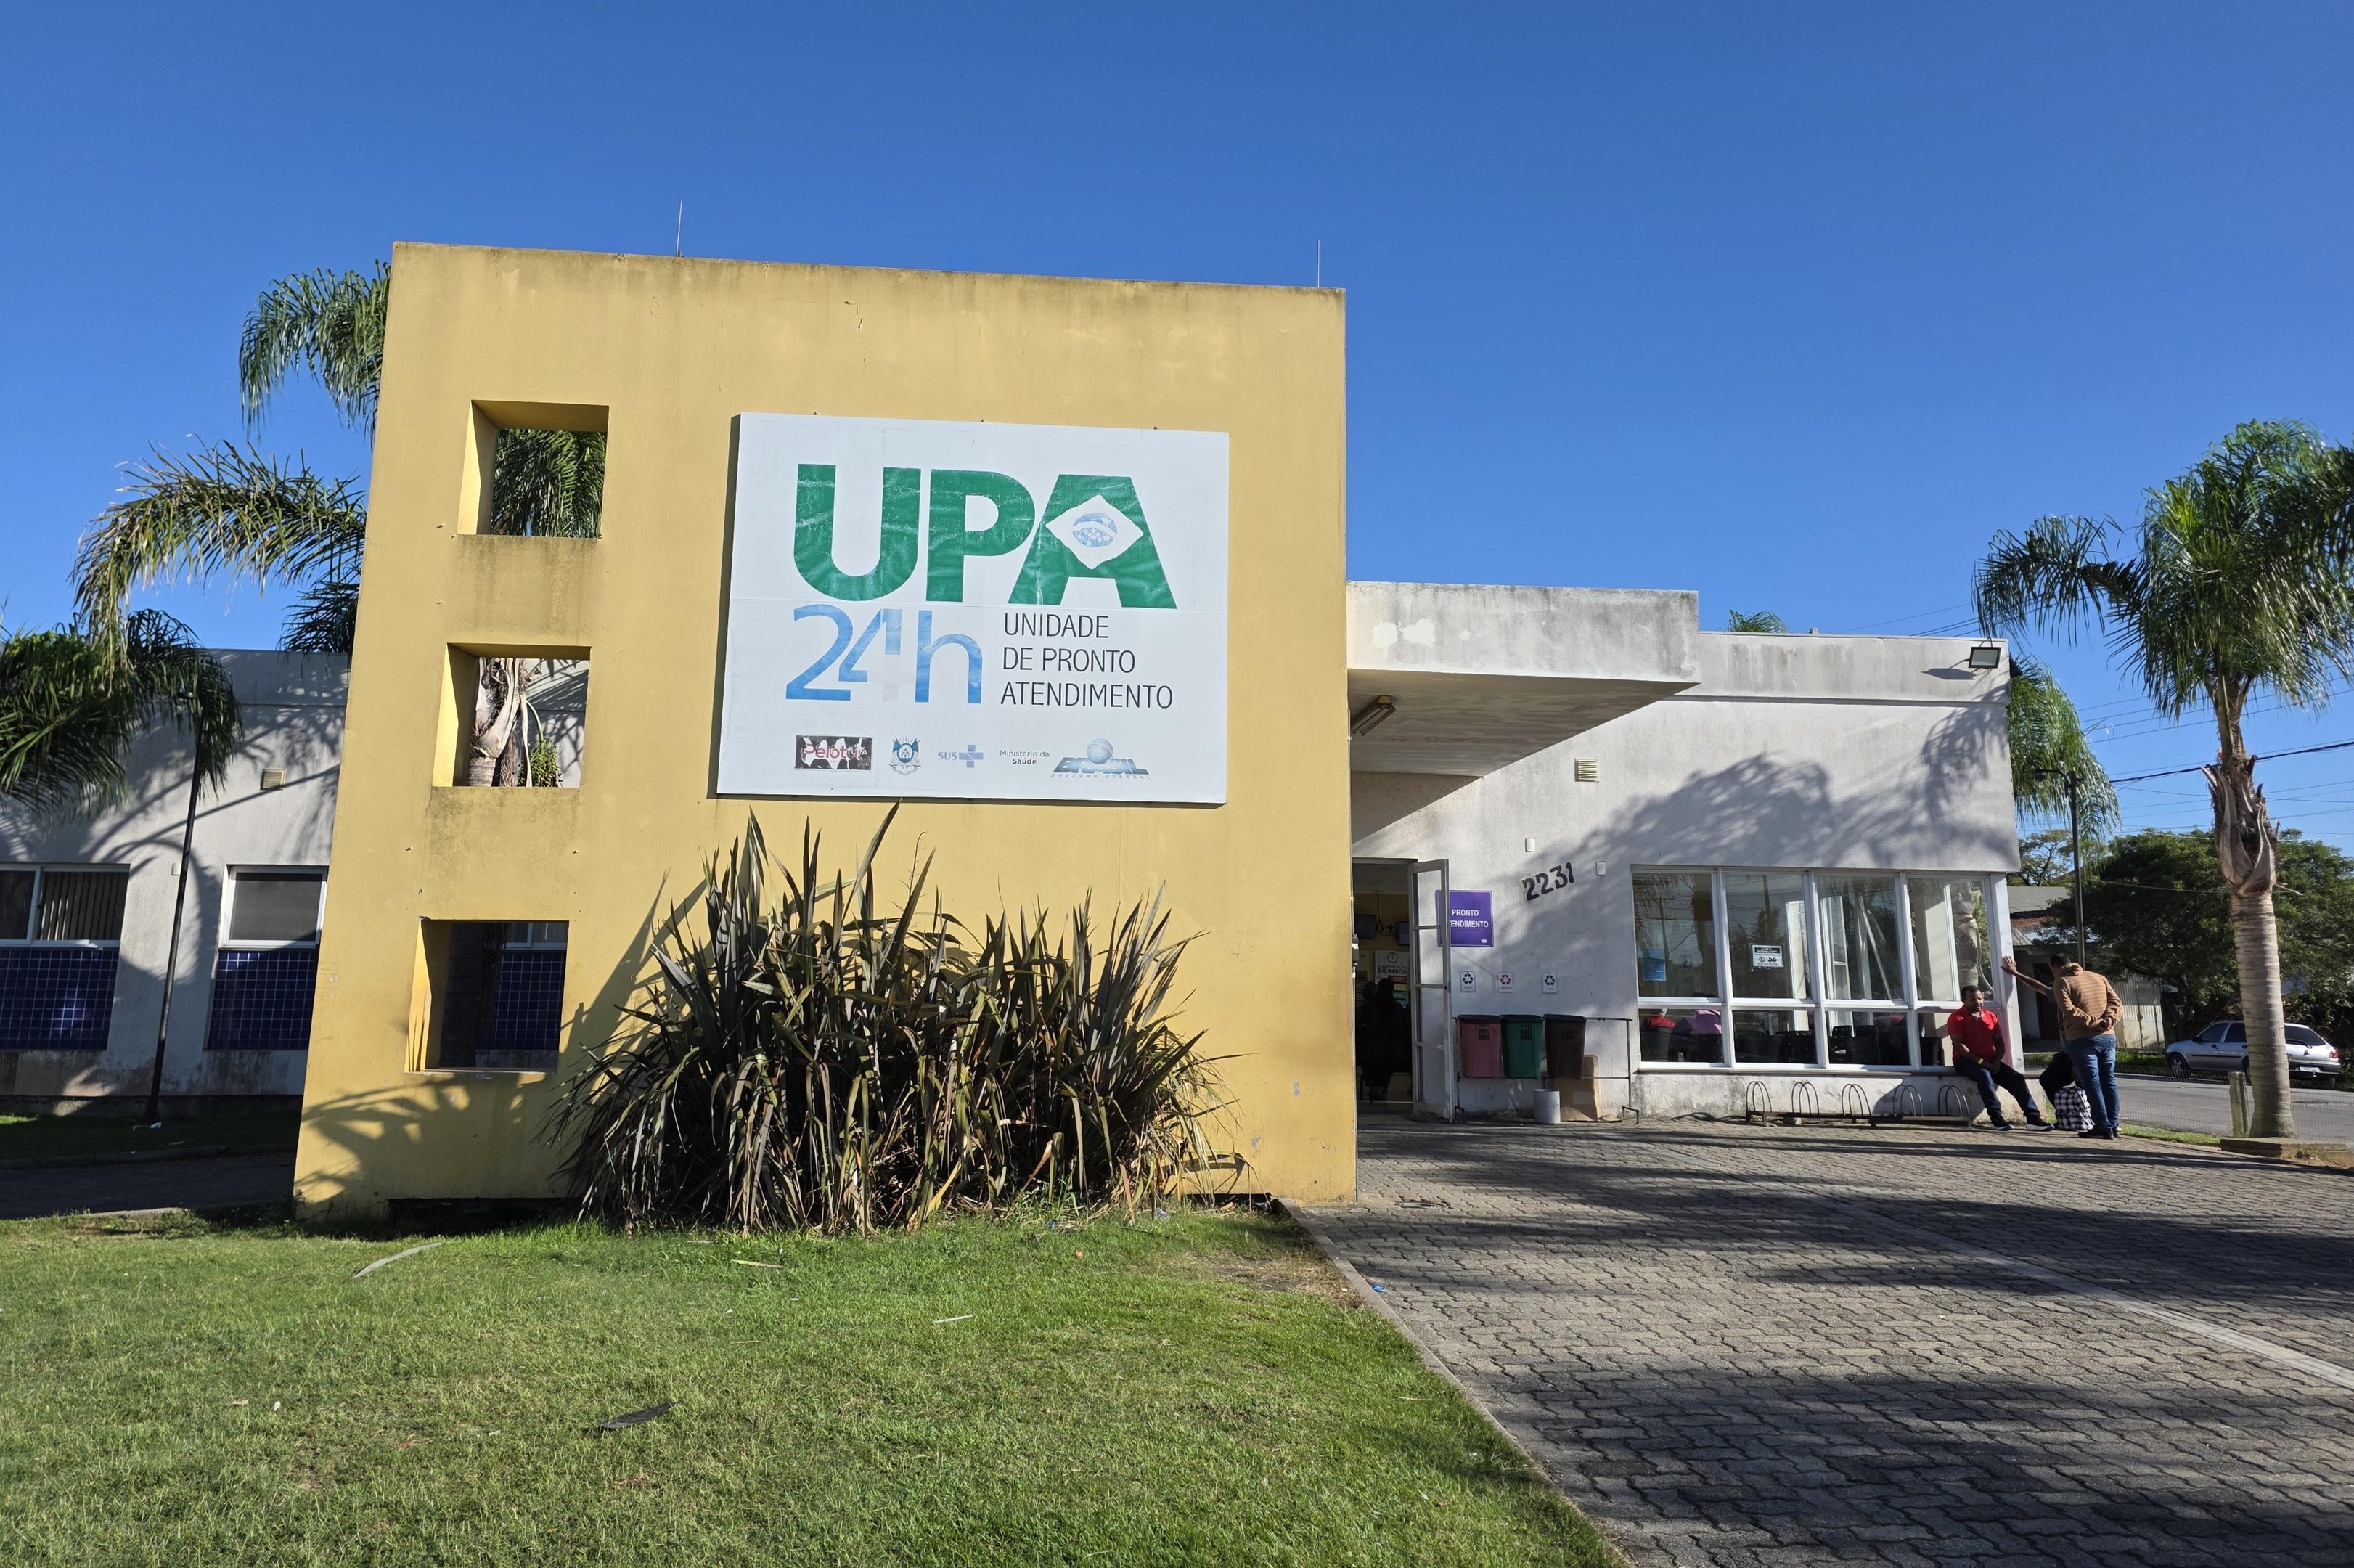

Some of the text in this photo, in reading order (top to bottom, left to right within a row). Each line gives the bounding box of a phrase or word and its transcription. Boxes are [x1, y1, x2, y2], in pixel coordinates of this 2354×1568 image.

[794, 463, 1177, 609] UPA
[1004, 612, 1109, 638] UNIDADE
[786, 604, 983, 703] 24h
[1003, 646, 1135, 673] DE PRONTO
[1000, 681, 1173, 709] ATENDIMENTO
[937, 751, 957, 760] SUS
[1053, 757, 1149, 775] BRASIL
[1521, 862, 1574, 901] 2231
